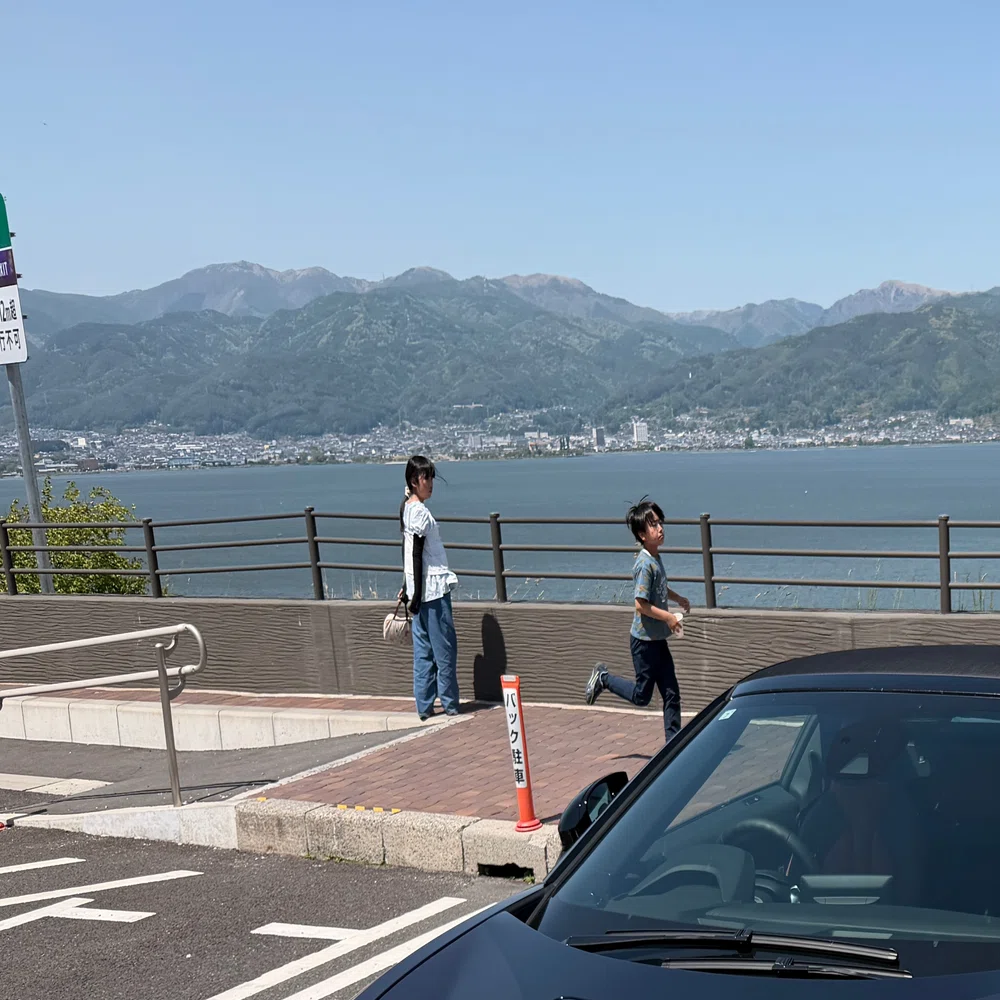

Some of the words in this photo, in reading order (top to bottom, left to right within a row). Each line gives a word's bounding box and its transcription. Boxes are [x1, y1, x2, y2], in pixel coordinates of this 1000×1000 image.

[506, 693, 525, 784] バック駐車
